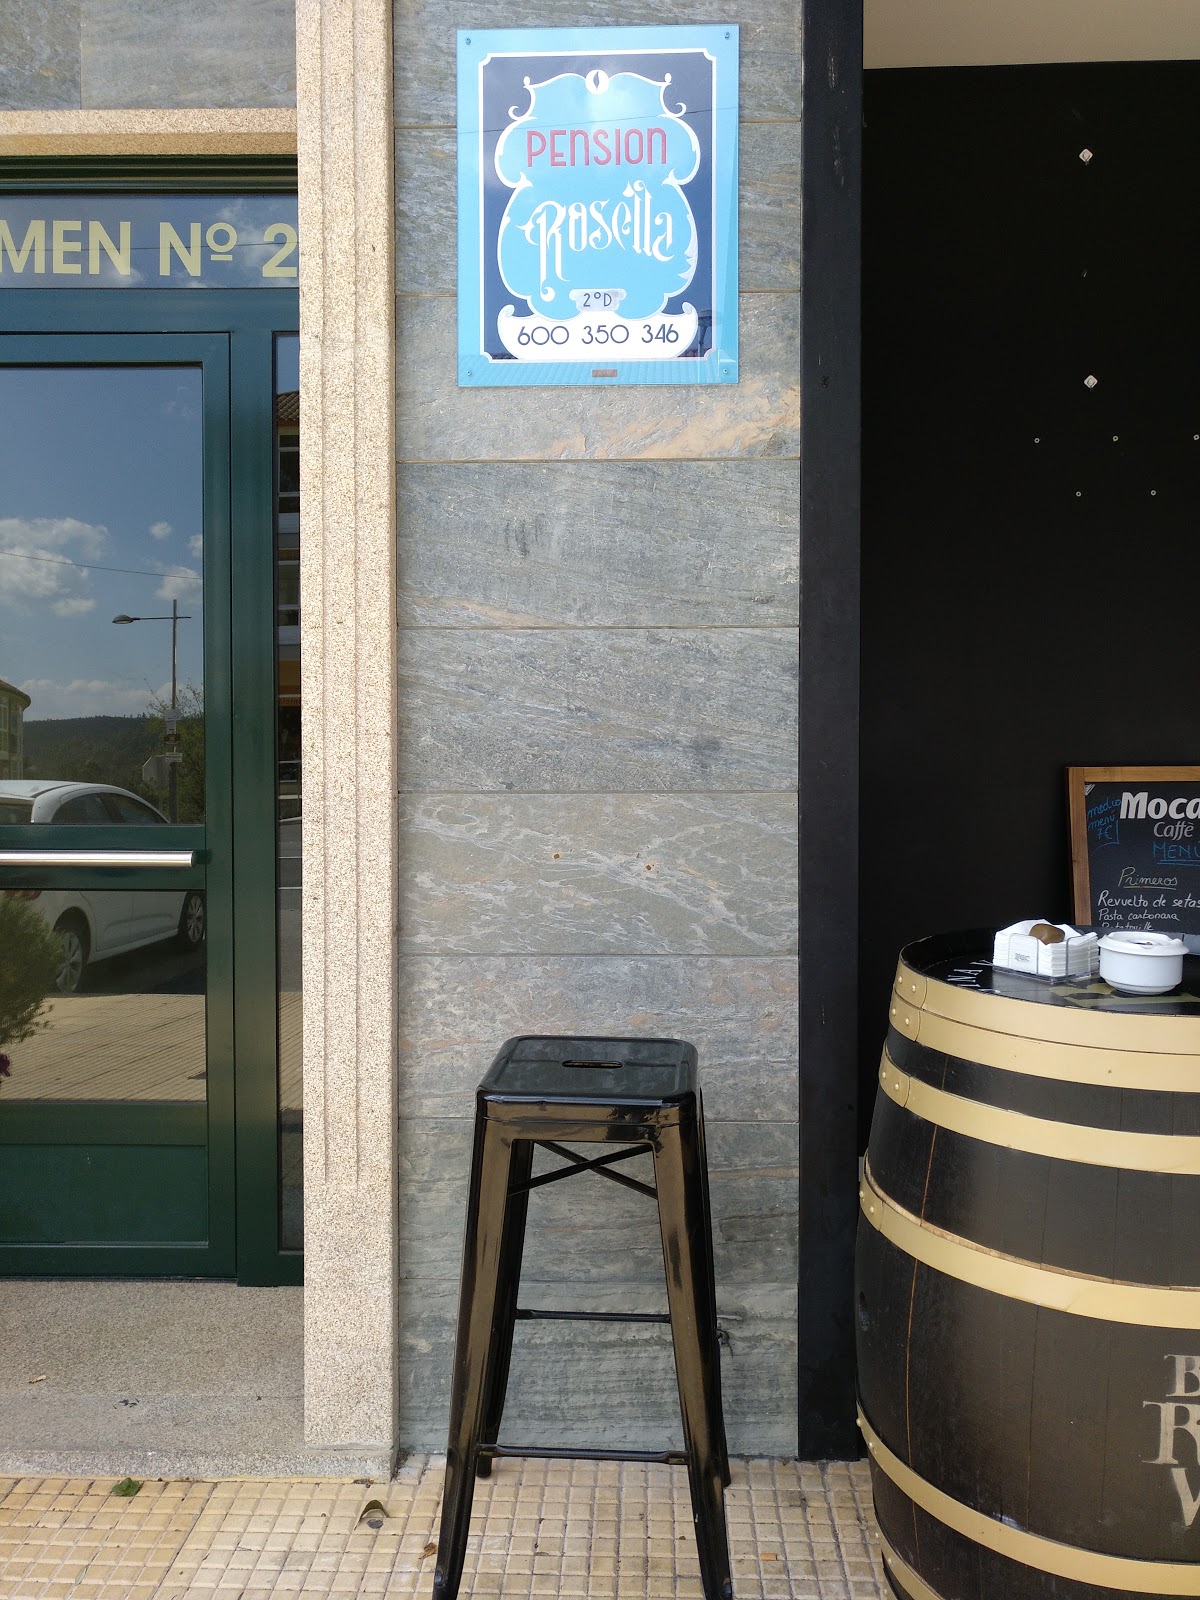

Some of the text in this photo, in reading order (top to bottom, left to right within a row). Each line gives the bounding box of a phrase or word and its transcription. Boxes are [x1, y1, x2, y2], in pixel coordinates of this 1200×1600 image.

[0, 219, 131, 275] MEN
[262, 222, 298, 278] 2
[516, 179, 675, 302] Rosella
[517, 323, 679, 346] 600 350 346
[1153, 820, 1195, 841] Caffè
[1117, 866, 1178, 888] Primeros
[1097, 889, 1149, 908] Revuelto
[1152, 893, 1167, 908] de
[1098, 907, 1181, 922] Pasta carbonara
